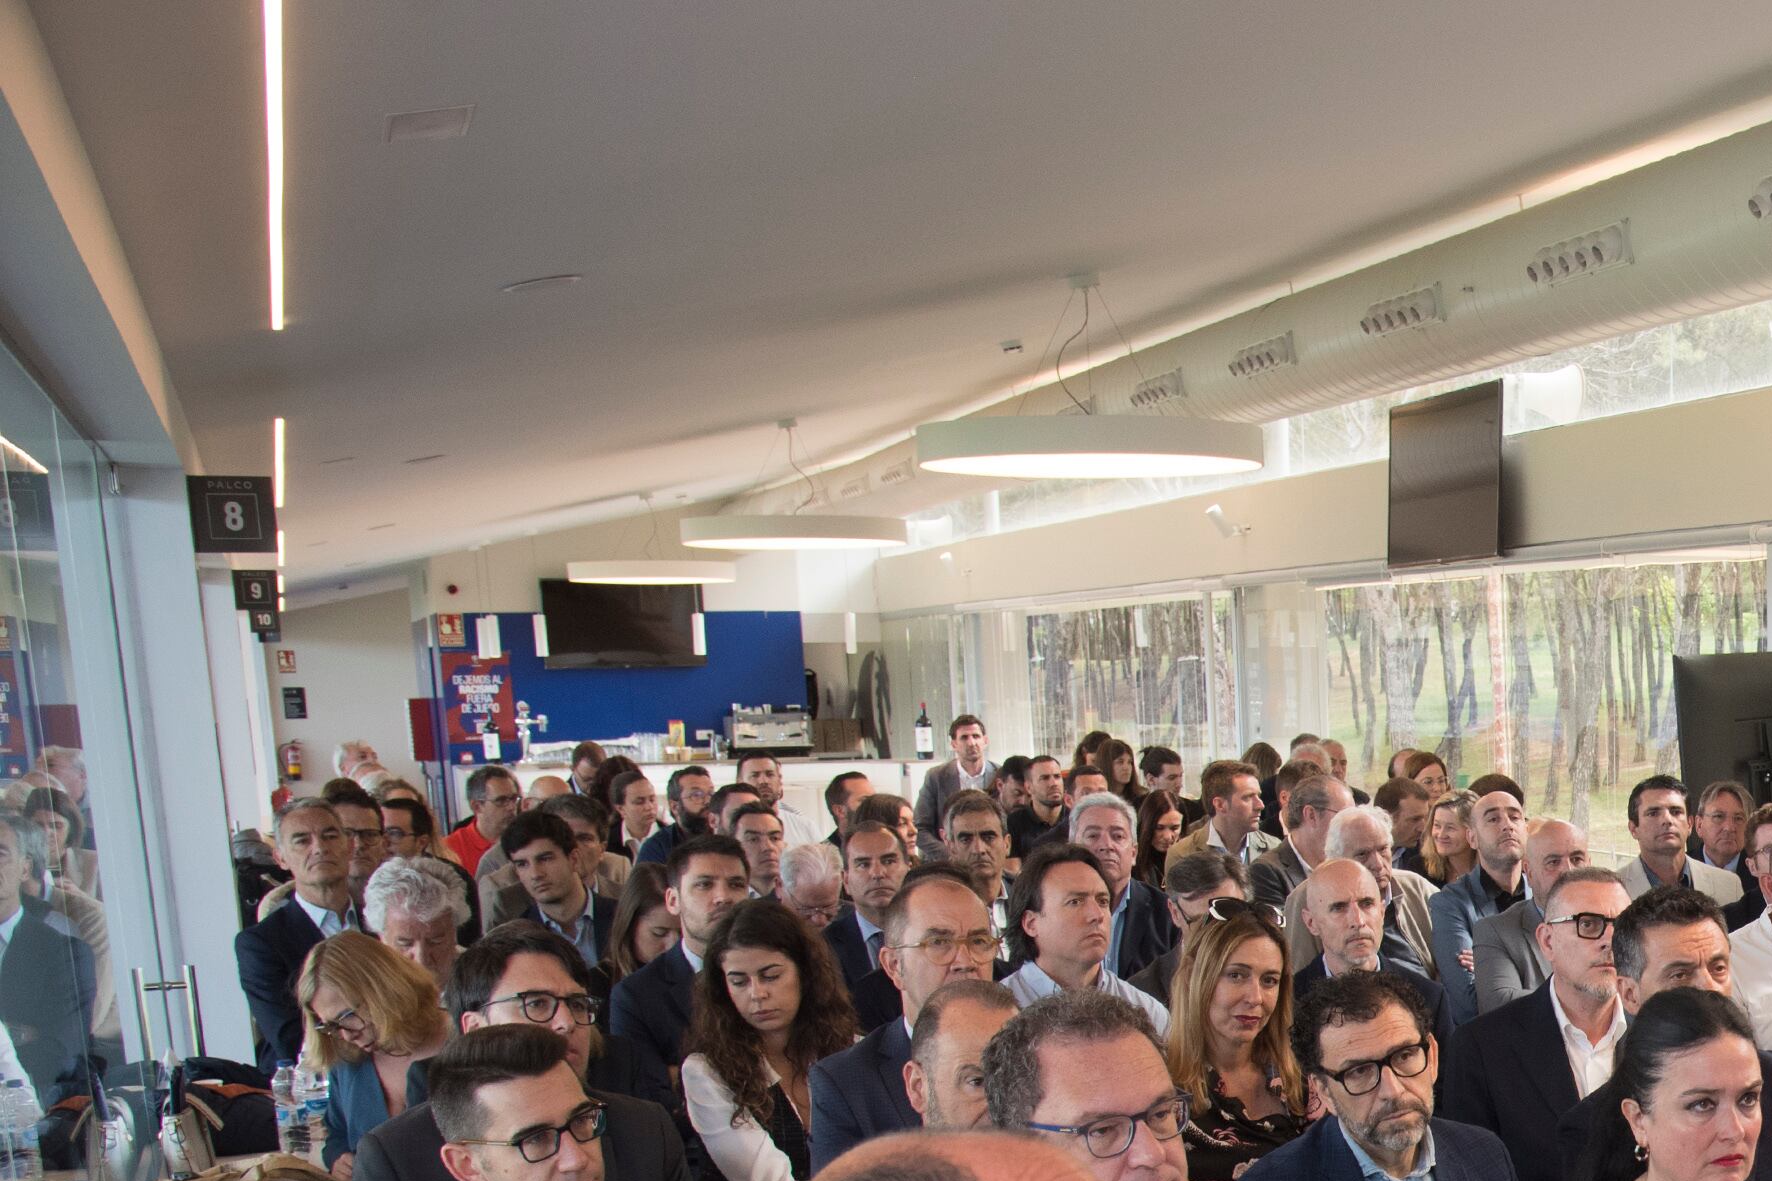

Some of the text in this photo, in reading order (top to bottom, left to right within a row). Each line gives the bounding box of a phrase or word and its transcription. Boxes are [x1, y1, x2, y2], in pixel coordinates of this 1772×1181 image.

[208, 481, 252, 489] PALCO
[224, 501, 244, 531] 8
[250, 583, 262, 599] 9
[257, 613, 271, 625] 10
[452, 675, 504, 685] DEJEMOS AL
[466, 694, 493, 704] FUERA
[461, 703, 472, 713] DE
